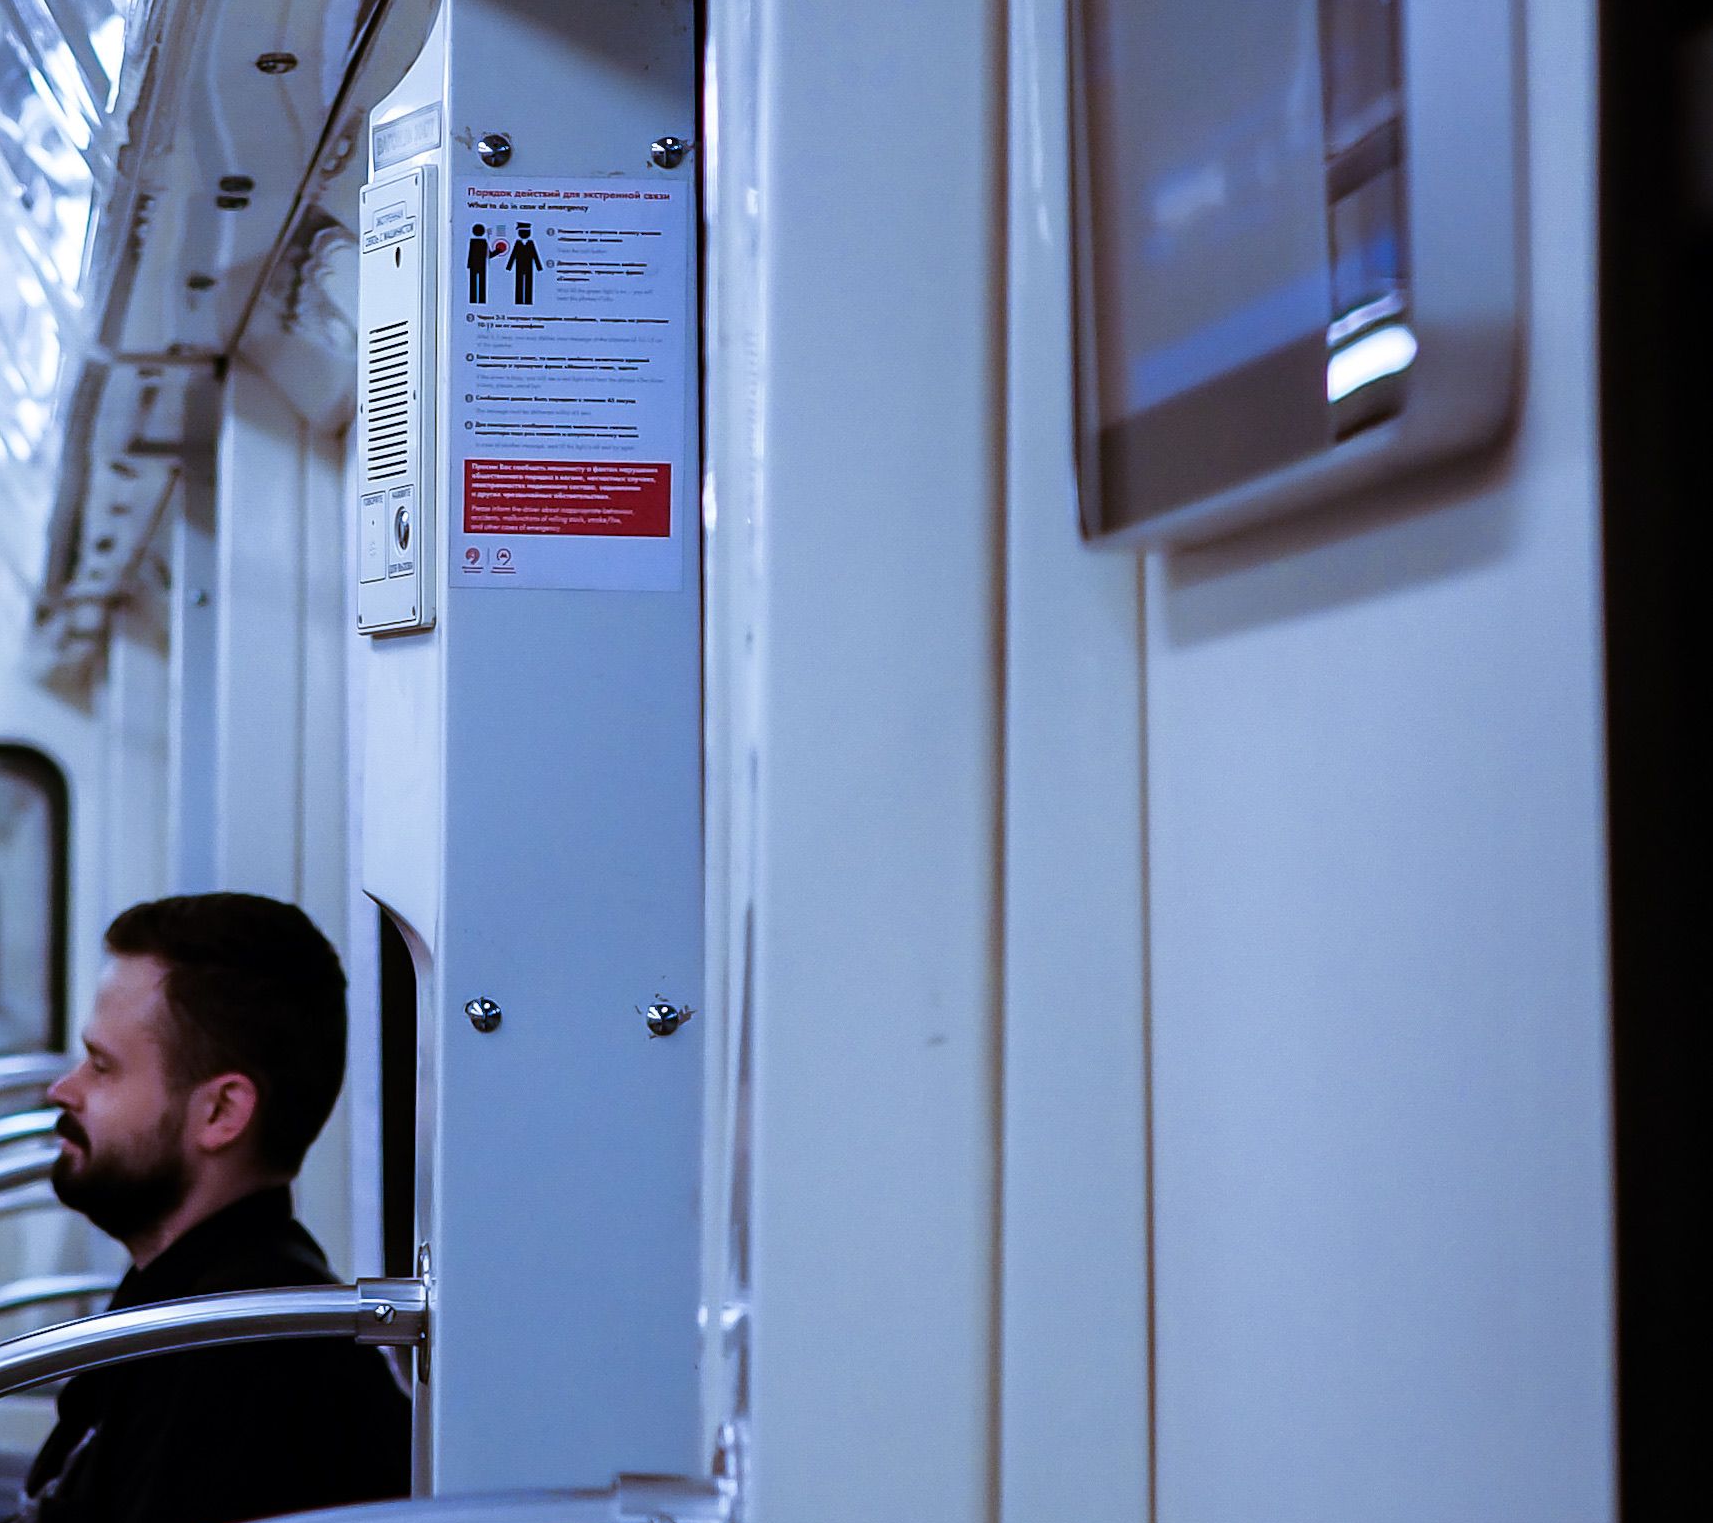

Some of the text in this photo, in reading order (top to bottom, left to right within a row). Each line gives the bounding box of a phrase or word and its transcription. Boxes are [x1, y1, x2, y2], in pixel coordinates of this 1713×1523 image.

[467, 187, 512, 198] Порядок
[514, 189, 560, 198] действий
[563, 191, 580, 199] для
[583, 191, 641, 201] экстренной
[467, 201, 488, 209] What
[538, 202, 546, 210] of
[547, 204, 589, 213] emergency
